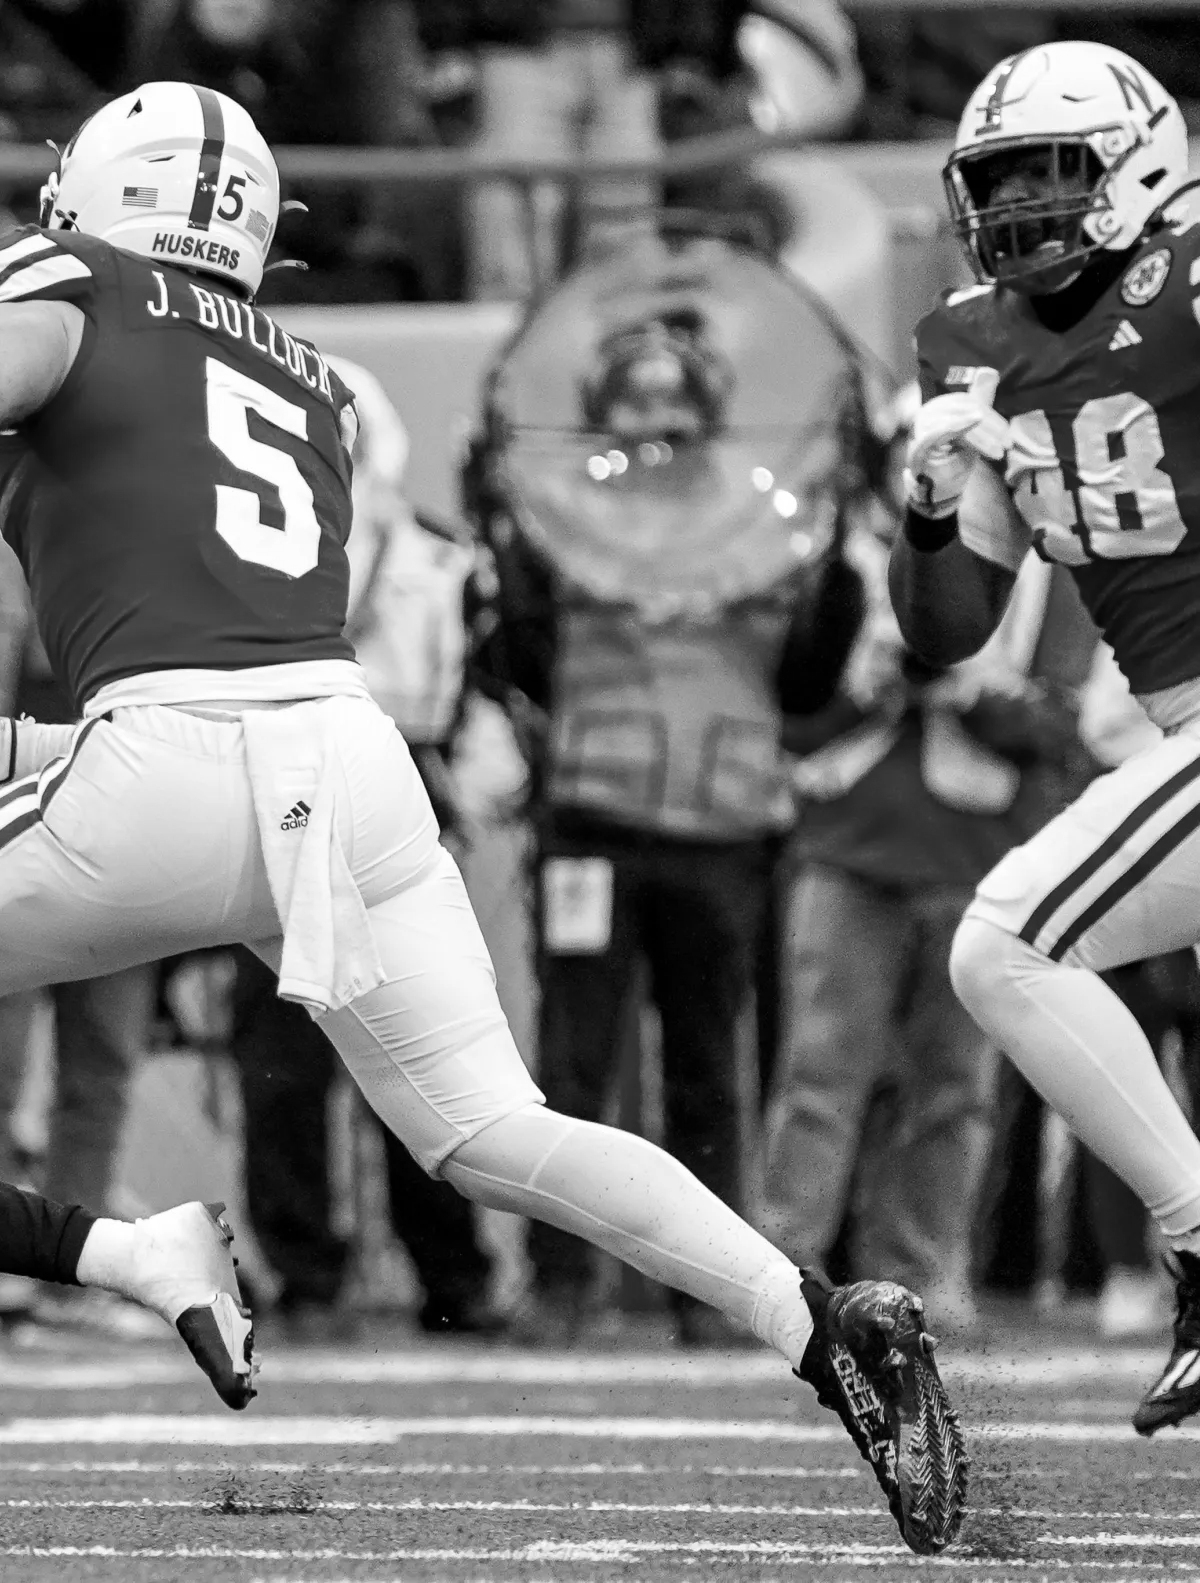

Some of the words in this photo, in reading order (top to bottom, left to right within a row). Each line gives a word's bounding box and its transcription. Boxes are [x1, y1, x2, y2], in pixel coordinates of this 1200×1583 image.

[1105, 62, 1156, 114] N
[216, 174, 247, 221] 5
[152, 232, 240, 271] HUSKERS
[147, 270, 181, 319] J.
[189, 281, 335, 403] BULLOCK
[205, 355, 322, 579] 5
